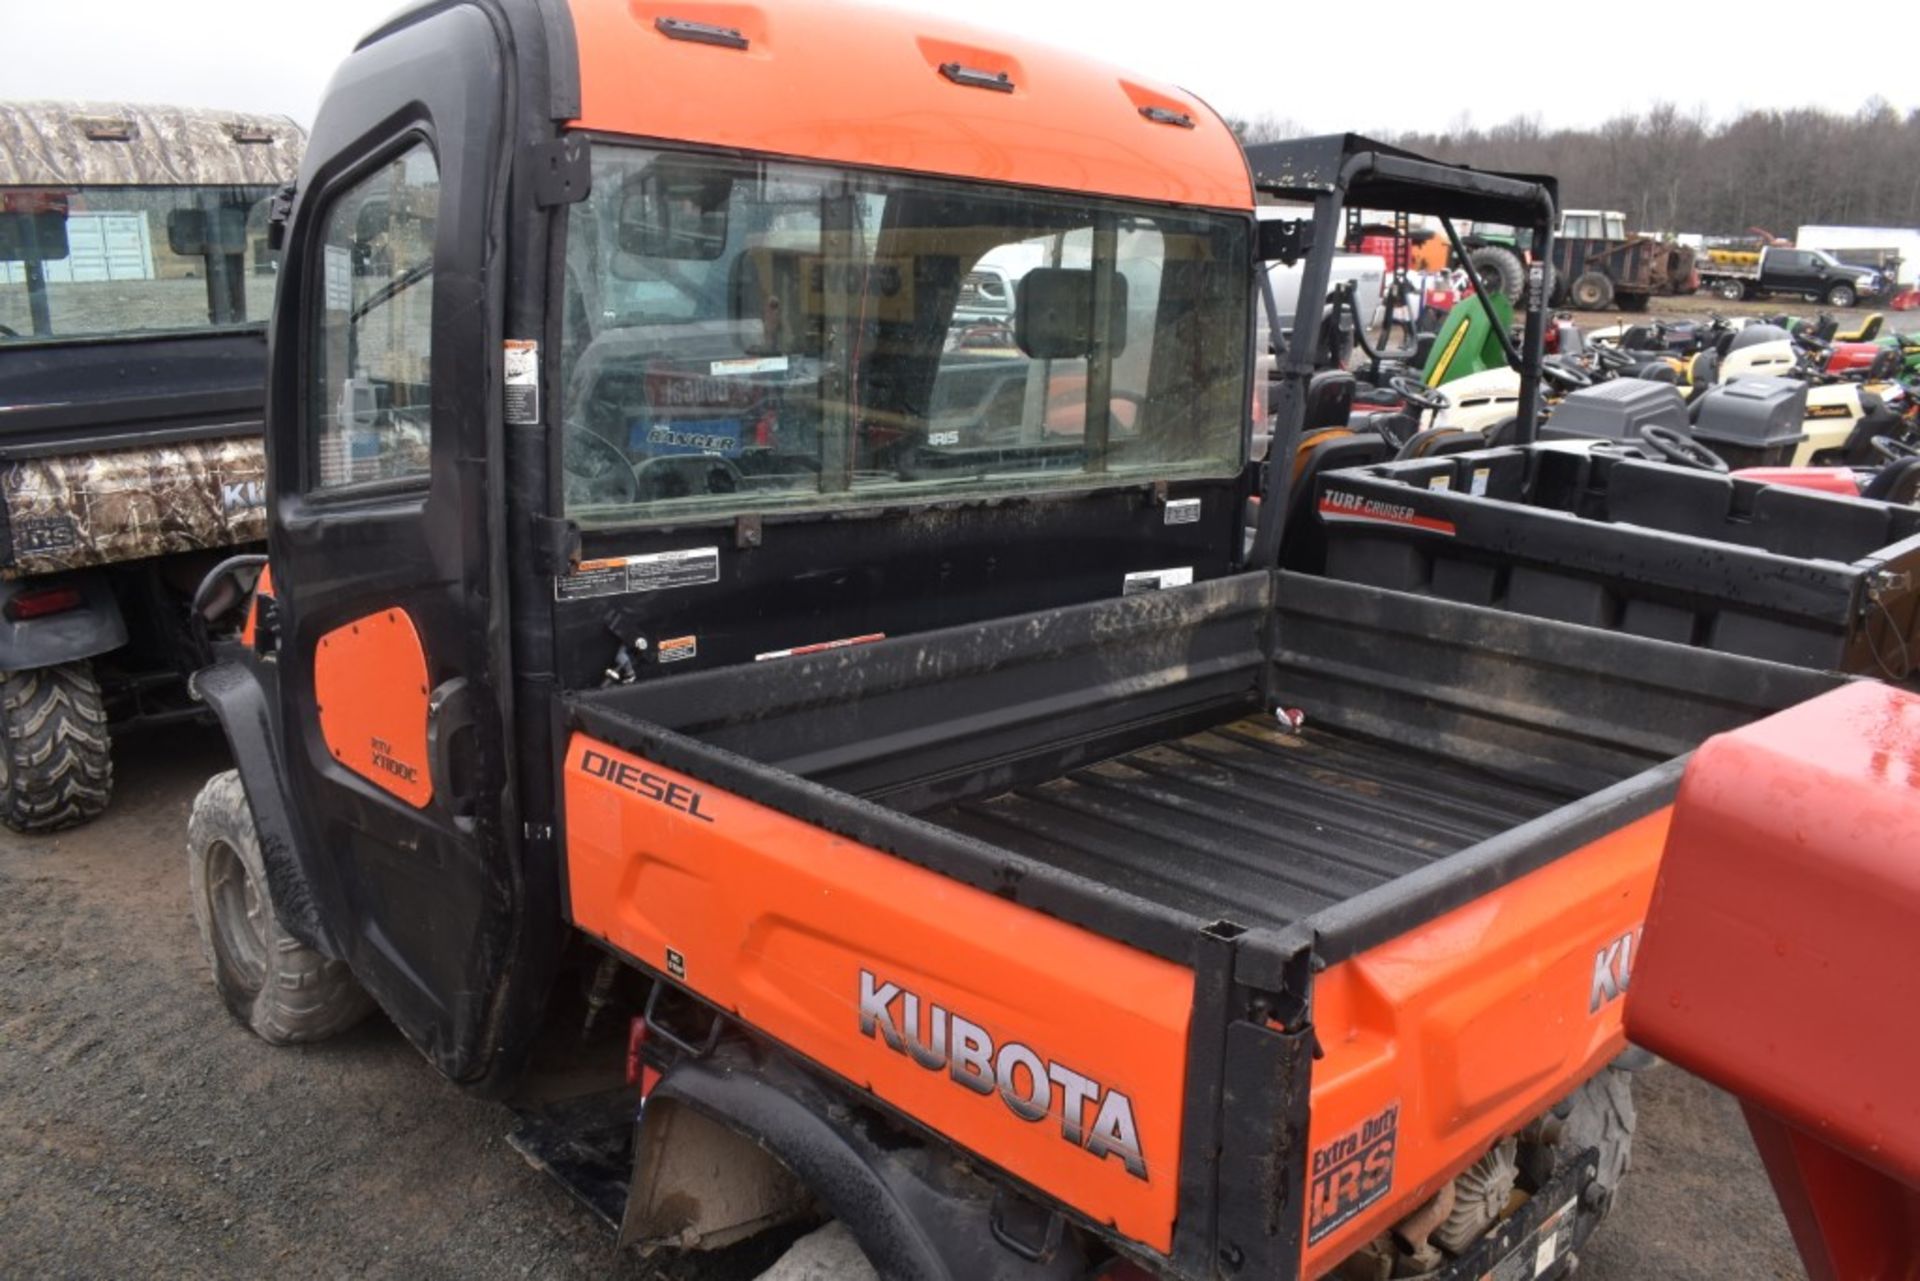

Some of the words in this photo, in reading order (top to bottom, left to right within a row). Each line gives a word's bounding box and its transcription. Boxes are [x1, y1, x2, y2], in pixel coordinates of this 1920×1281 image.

[647, 430, 735, 450] RANGER
[1324, 489, 1364, 510] TURF
[1364, 499, 1415, 522] CRUISER
[371, 736, 392, 755] RTV
[372, 751, 418, 784] X1100C
[581, 750, 715, 823] DIESEL
[860, 968, 1149, 1183] KUBOTA
[1314, 1132, 1358, 1175] Extra
[1361, 1105, 1399, 1148] Duty
[1311, 1140, 1392, 1228] IRS
